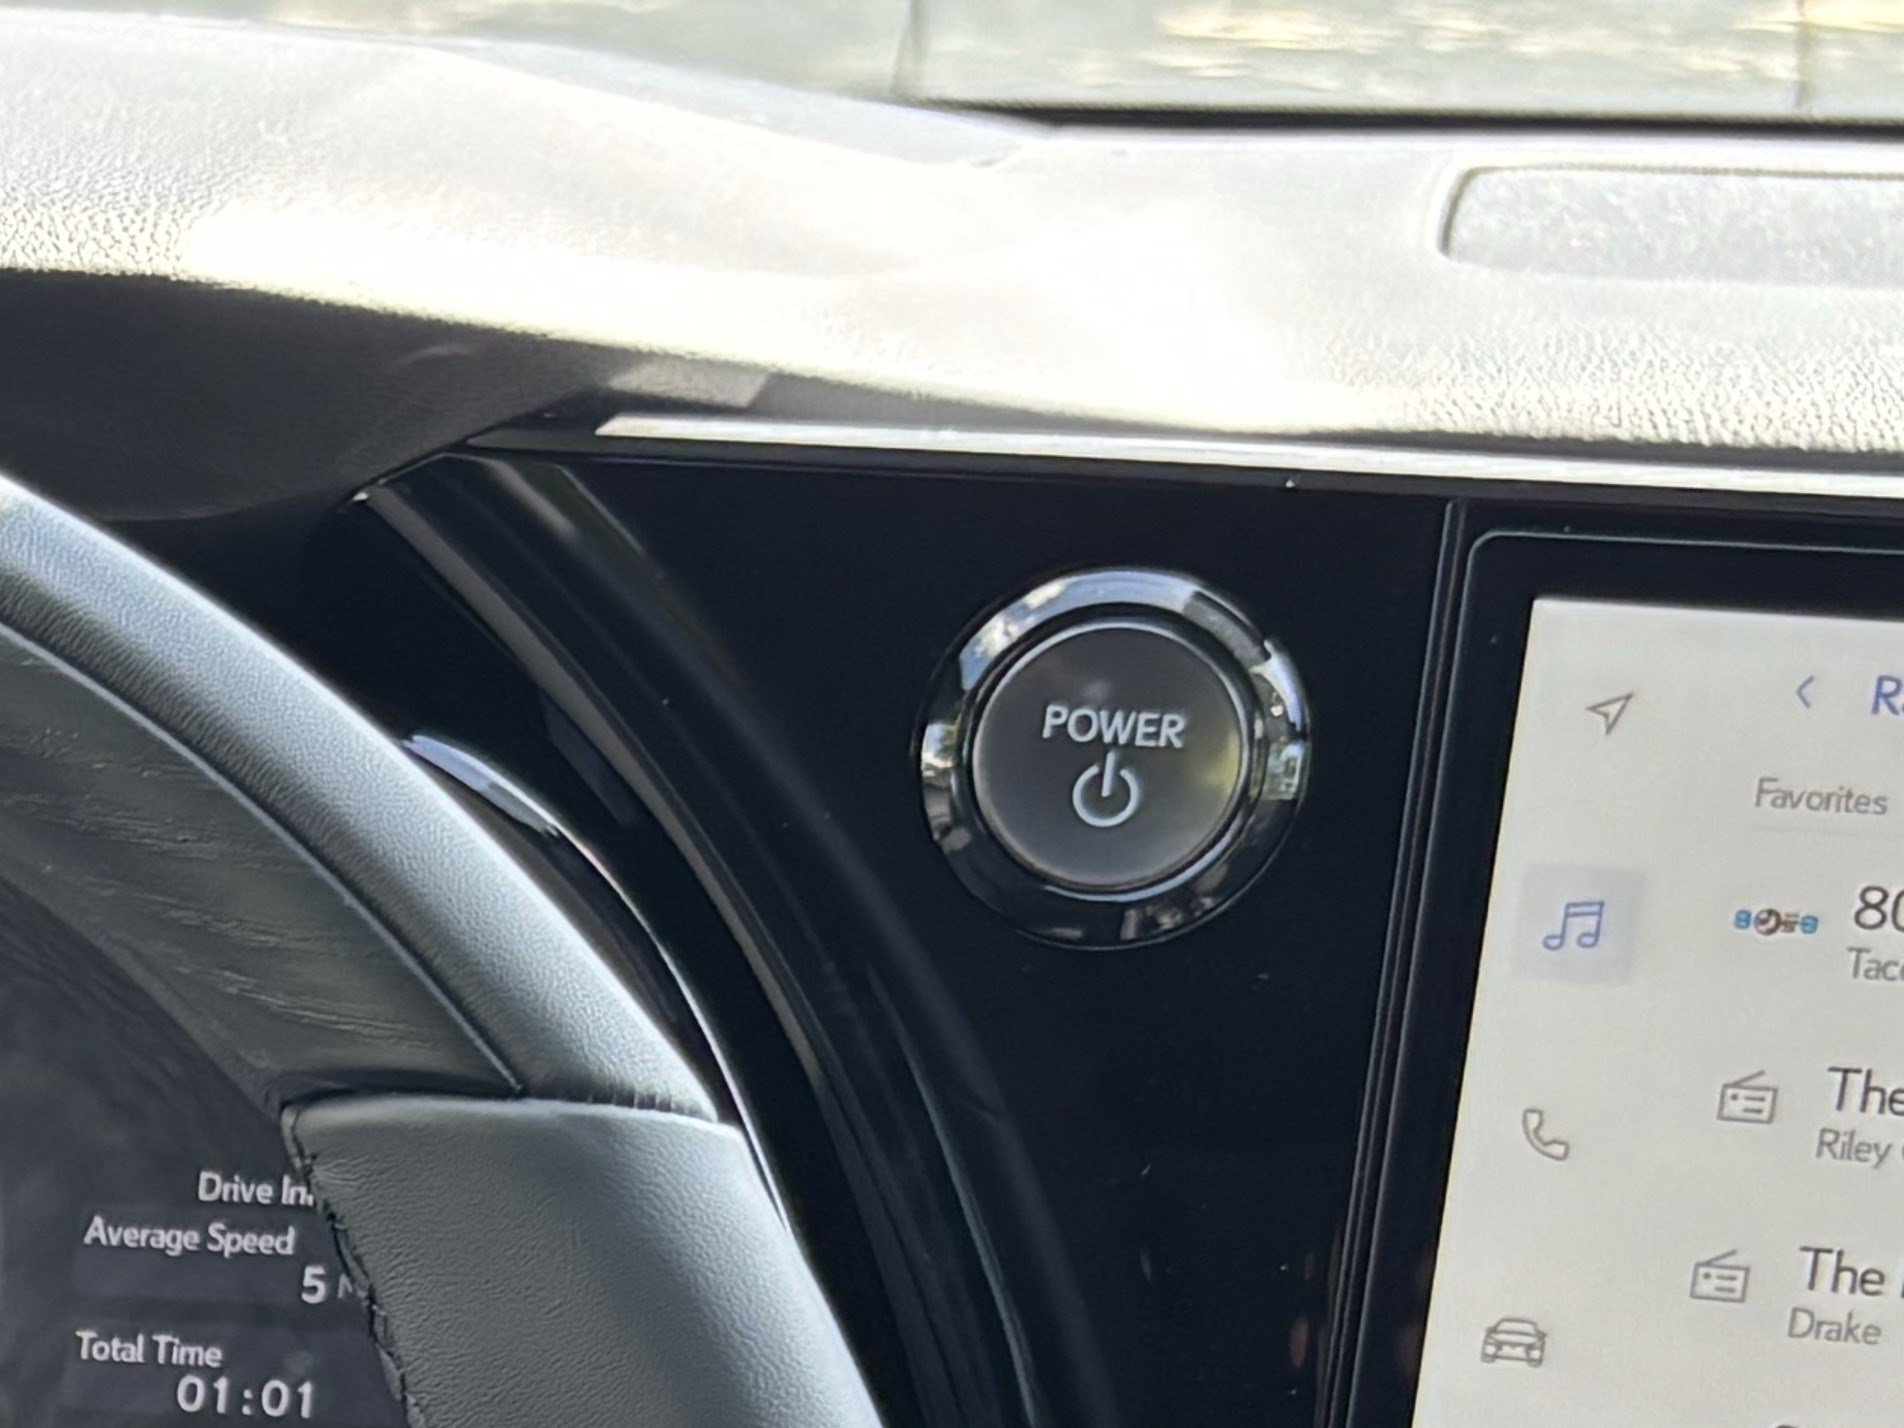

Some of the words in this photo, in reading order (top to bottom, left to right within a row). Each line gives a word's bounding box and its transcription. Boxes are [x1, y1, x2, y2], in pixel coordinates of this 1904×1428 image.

[1042, 704, 1186, 749] POWER
[1754, 775, 1888, 816] Favorites
[1815, 1127, 1893, 1170] Riley
[197, 1170, 274, 1205] Drive
[84, 1215, 200, 1256] Average
[206, 1222, 295, 1258] Speed
[301, 1264, 327, 1304] 5
[1799, 1245, 1886, 1298] The
[1787, 1306, 1883, 1346] Drake
[76, 1330, 145, 1366] Total
[153, 1333, 223, 1370] Time
[176, 1376, 316, 1419] 01:01
